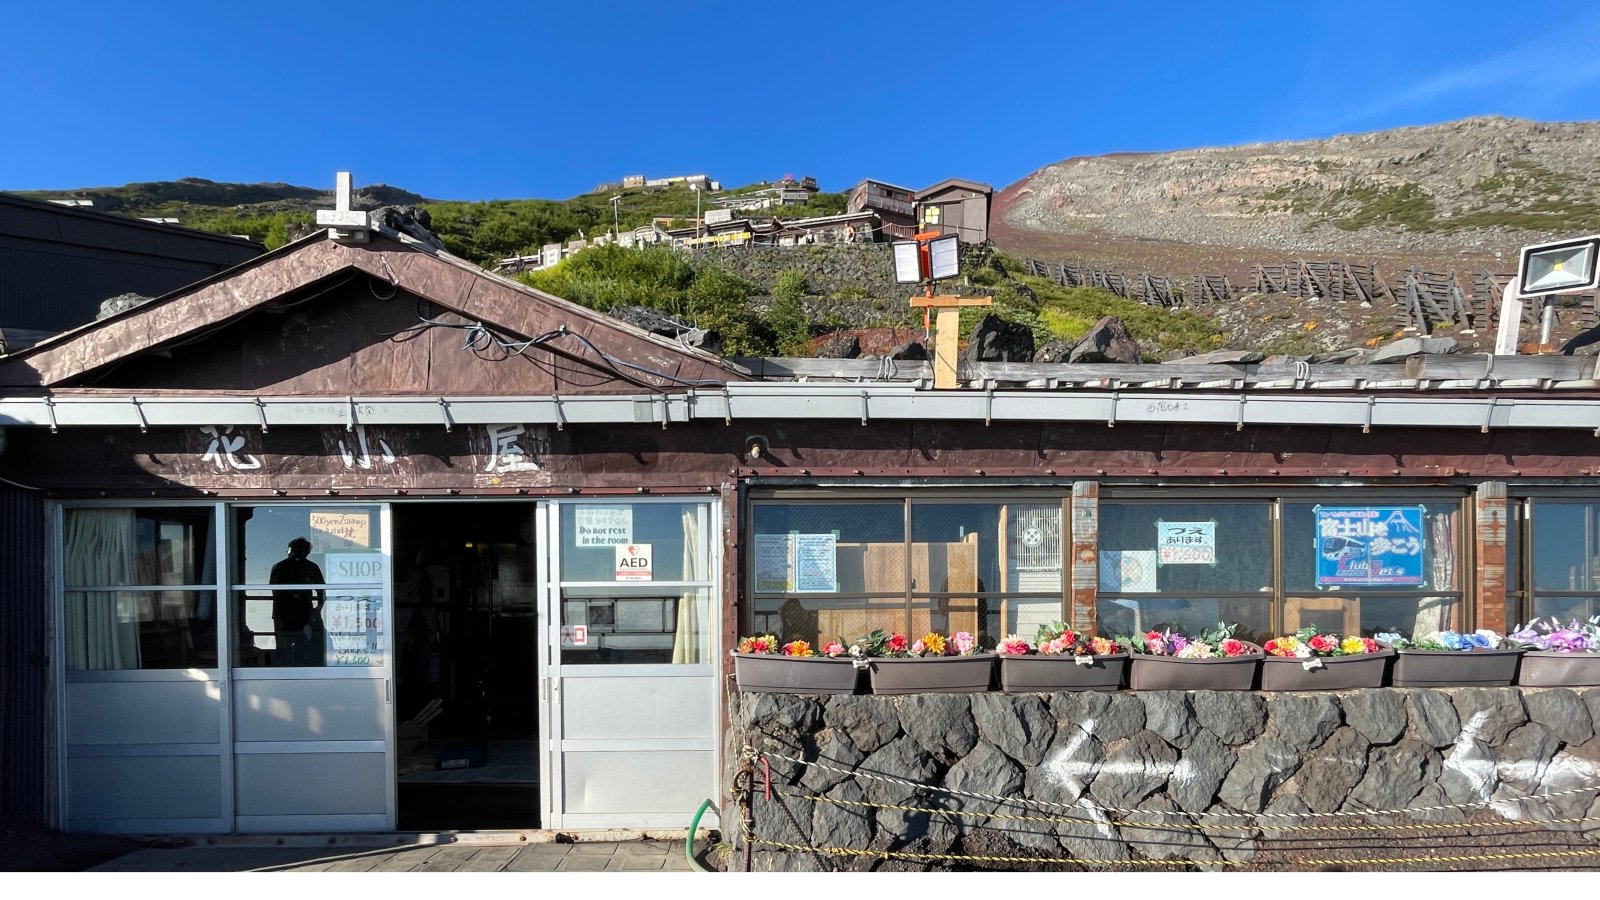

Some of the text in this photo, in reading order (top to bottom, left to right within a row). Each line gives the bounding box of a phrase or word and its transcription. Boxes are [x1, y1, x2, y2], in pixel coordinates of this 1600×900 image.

[579, 525, 627, 535] Do not rest
[1167, 527, 1208, 536] つえ
[1319, 518, 1389, 537] 富士山を
[582, 536, 629, 545] in the room
[1370, 536, 1419, 556] 歩こう
[338, 560, 382, 577] SHOP
[620, 557, 648, 568] AED
[1337, 554, 1369, 571] Club
[562, 625, 585, 644] 入口
